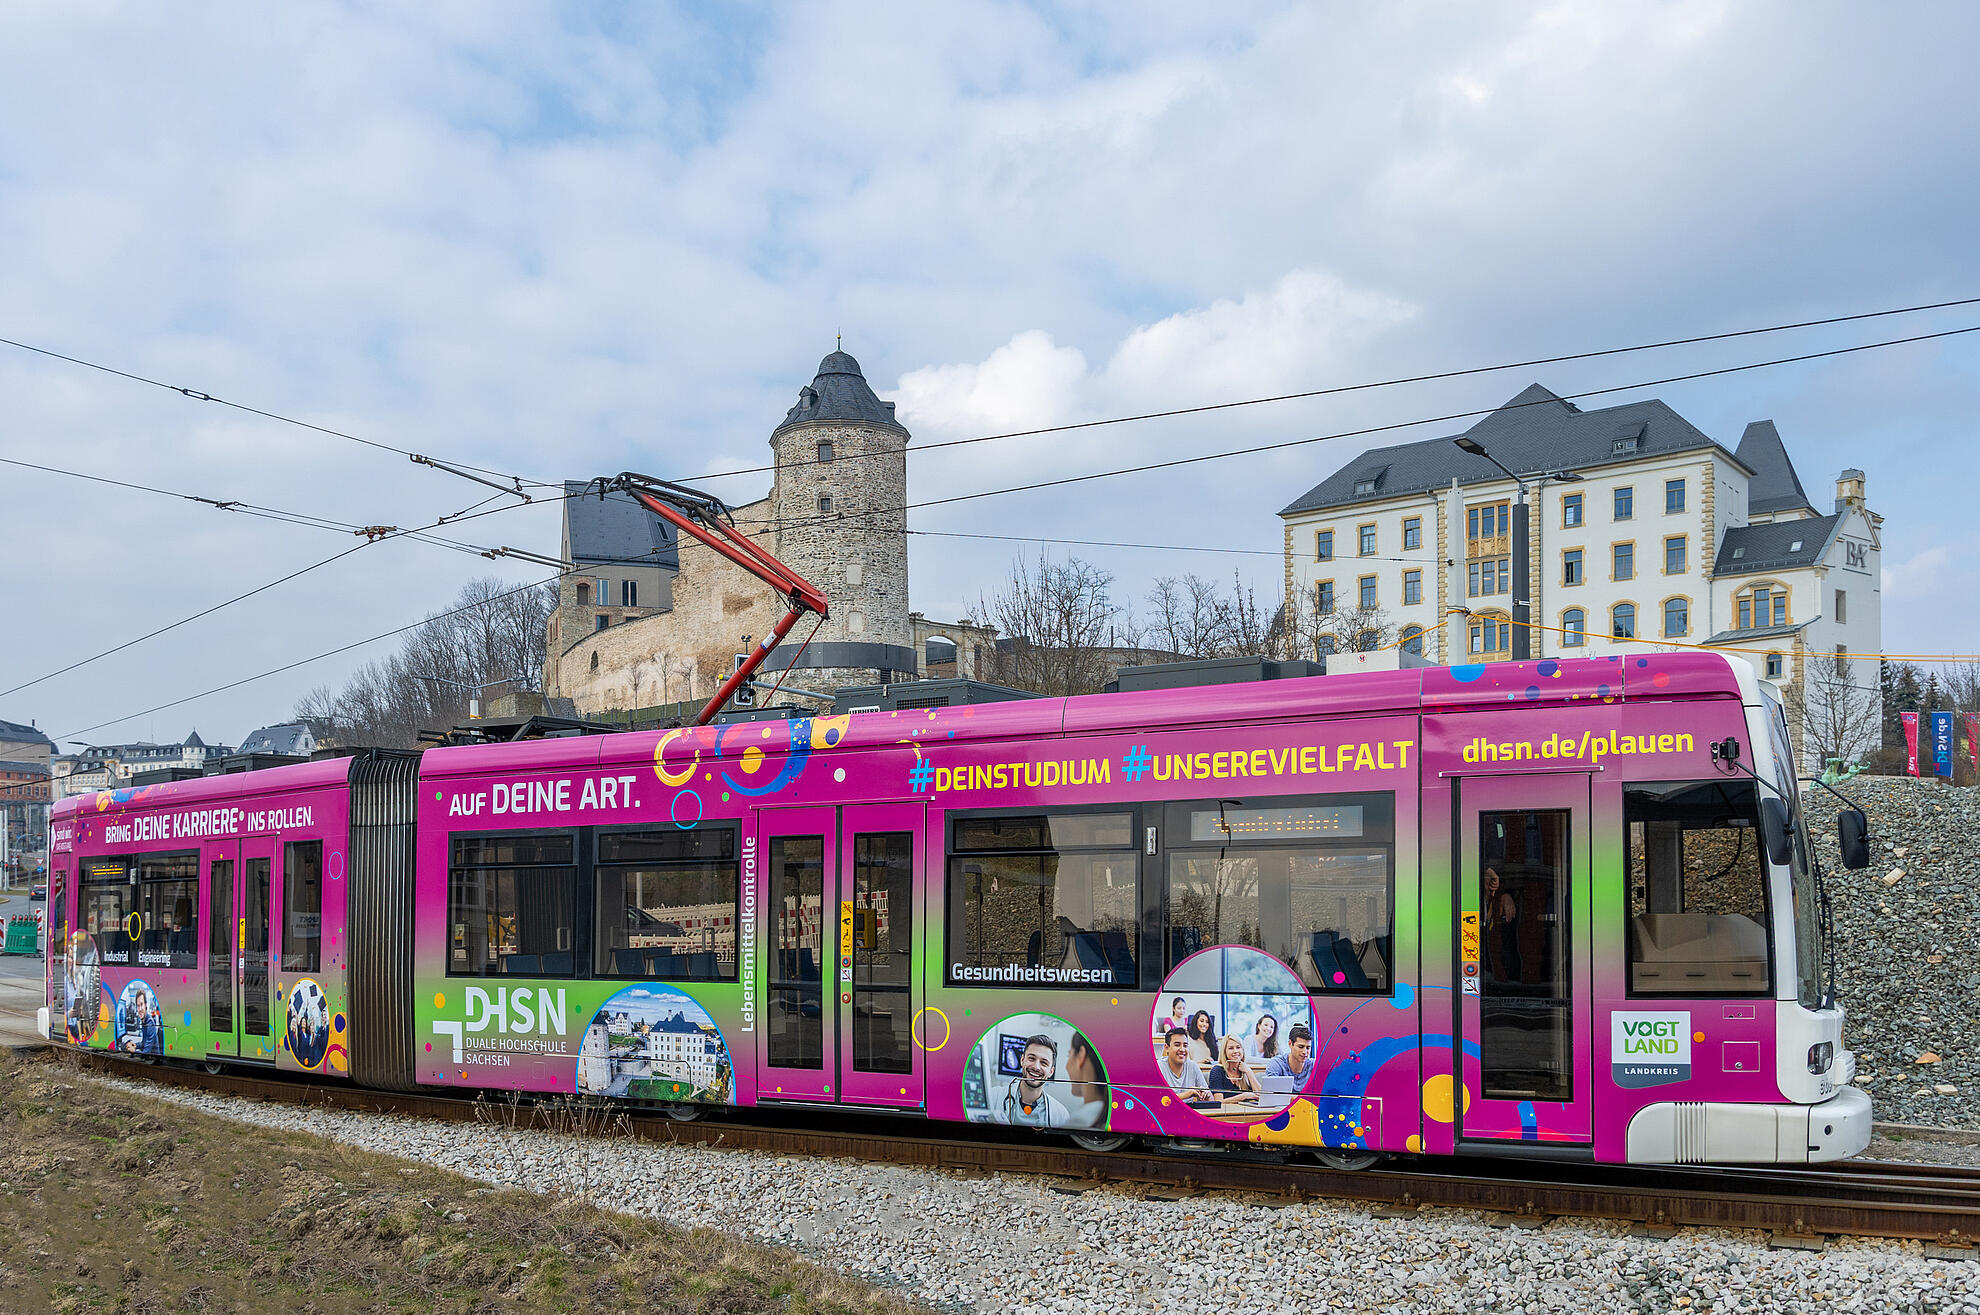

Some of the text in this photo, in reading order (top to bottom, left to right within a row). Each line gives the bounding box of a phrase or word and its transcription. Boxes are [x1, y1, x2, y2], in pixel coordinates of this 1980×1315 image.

[1463, 730, 1694, 763] dhsn.de/plauen
[909, 740, 1413, 793] #DEINSTUDIUM #UNSEREVIELFALT
[448, 775, 641, 817] AUF DEINE ART.
[105, 824, 131, 844] BRING
[133, 814, 171, 842] DEINE
[247, 810, 265, 832] INS
[267, 805, 315, 830] ROLLEN.
[741, 836, 756, 1033] Lebensmittelkontrolle
[103, 950, 171, 967] Industrial Engineering
[952, 962, 1112, 984] Gesundheitswesen
[465, 986, 567, 1036] DHSN
[1622, 1021, 1681, 1037] VOGT
[465, 1037, 568, 1053] DUALE HOCHSCHULE
[1624, 1038, 1679, 1054] LAND
[466, 1053, 511, 1067] SACHSEN
[1624, 1067, 1679, 1075] LANDKREIS
